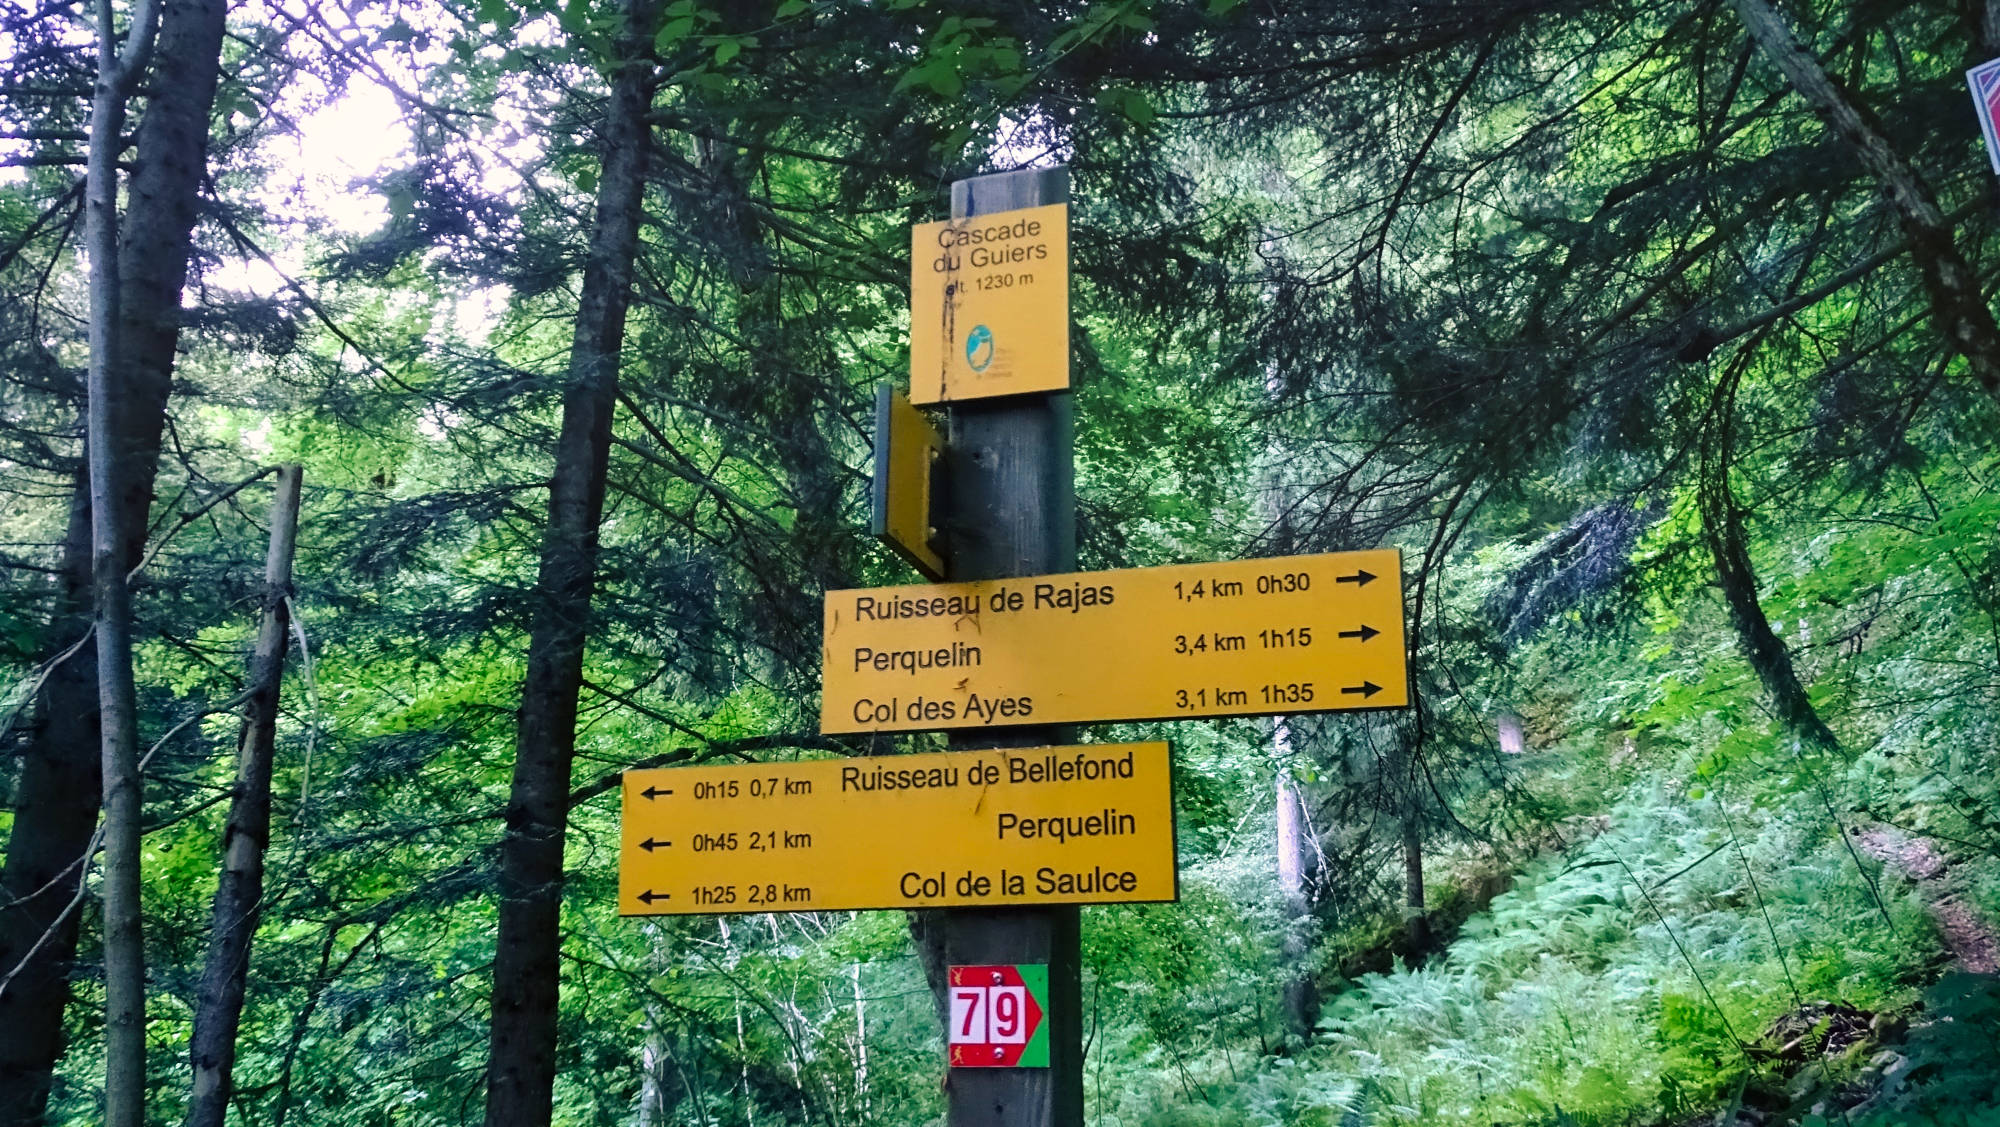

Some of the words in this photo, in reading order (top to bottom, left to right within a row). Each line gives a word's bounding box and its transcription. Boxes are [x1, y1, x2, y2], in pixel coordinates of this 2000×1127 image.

[938, 218, 1041, 248] Cascade
[933, 253, 960, 273] du
[970, 244, 1048, 267] Guiers
[976, 273, 1013, 291] 1230
[1019, 273, 1034, 285] m
[856, 595, 980, 622] Ruisseau
[990, 587, 1024, 613] de
[1034, 582, 1114, 613] Rajas
[1174, 580, 1205, 602] 1,4
[1212, 578, 1243, 598] km
[1256, 573, 1310, 595] 0h30
[1174, 634, 1207, 656] 3,4
[1215, 633, 1246, 652] km
[1258, 628, 1312, 649] 1h15
[854, 642, 981, 676] Perquelin
[853, 698, 897, 723] Col
[907, 696, 956, 720] des
[963, 693, 1033, 725] Ayes
[1175, 688, 1206, 711] 3,1
[1215, 687, 1247, 707] km
[1260, 683, 1314, 704] 1h35
[842, 765, 958, 792] Ruisseau
[967, 760, 999, 786] de
[1009, 751, 1134, 784] Bellefond
[693, 781, 739, 799] 0h15
[750, 778, 779, 799] 0,7
[785, 777, 812, 795] km
[997, 808, 1136, 844] Perquelin
[692, 833, 738, 852] 0h45
[748, 831, 776, 852] 2,1
[784, 830, 812, 848] km
[691, 886, 736, 905] 1h25
[748, 884, 777, 906] 2,8
[783, 884, 811, 902] km
[900, 871, 946, 898] Col
[956, 870, 991, 896] de
[1001, 869, 1026, 895] la
[1035, 866, 1137, 894] Saulce
